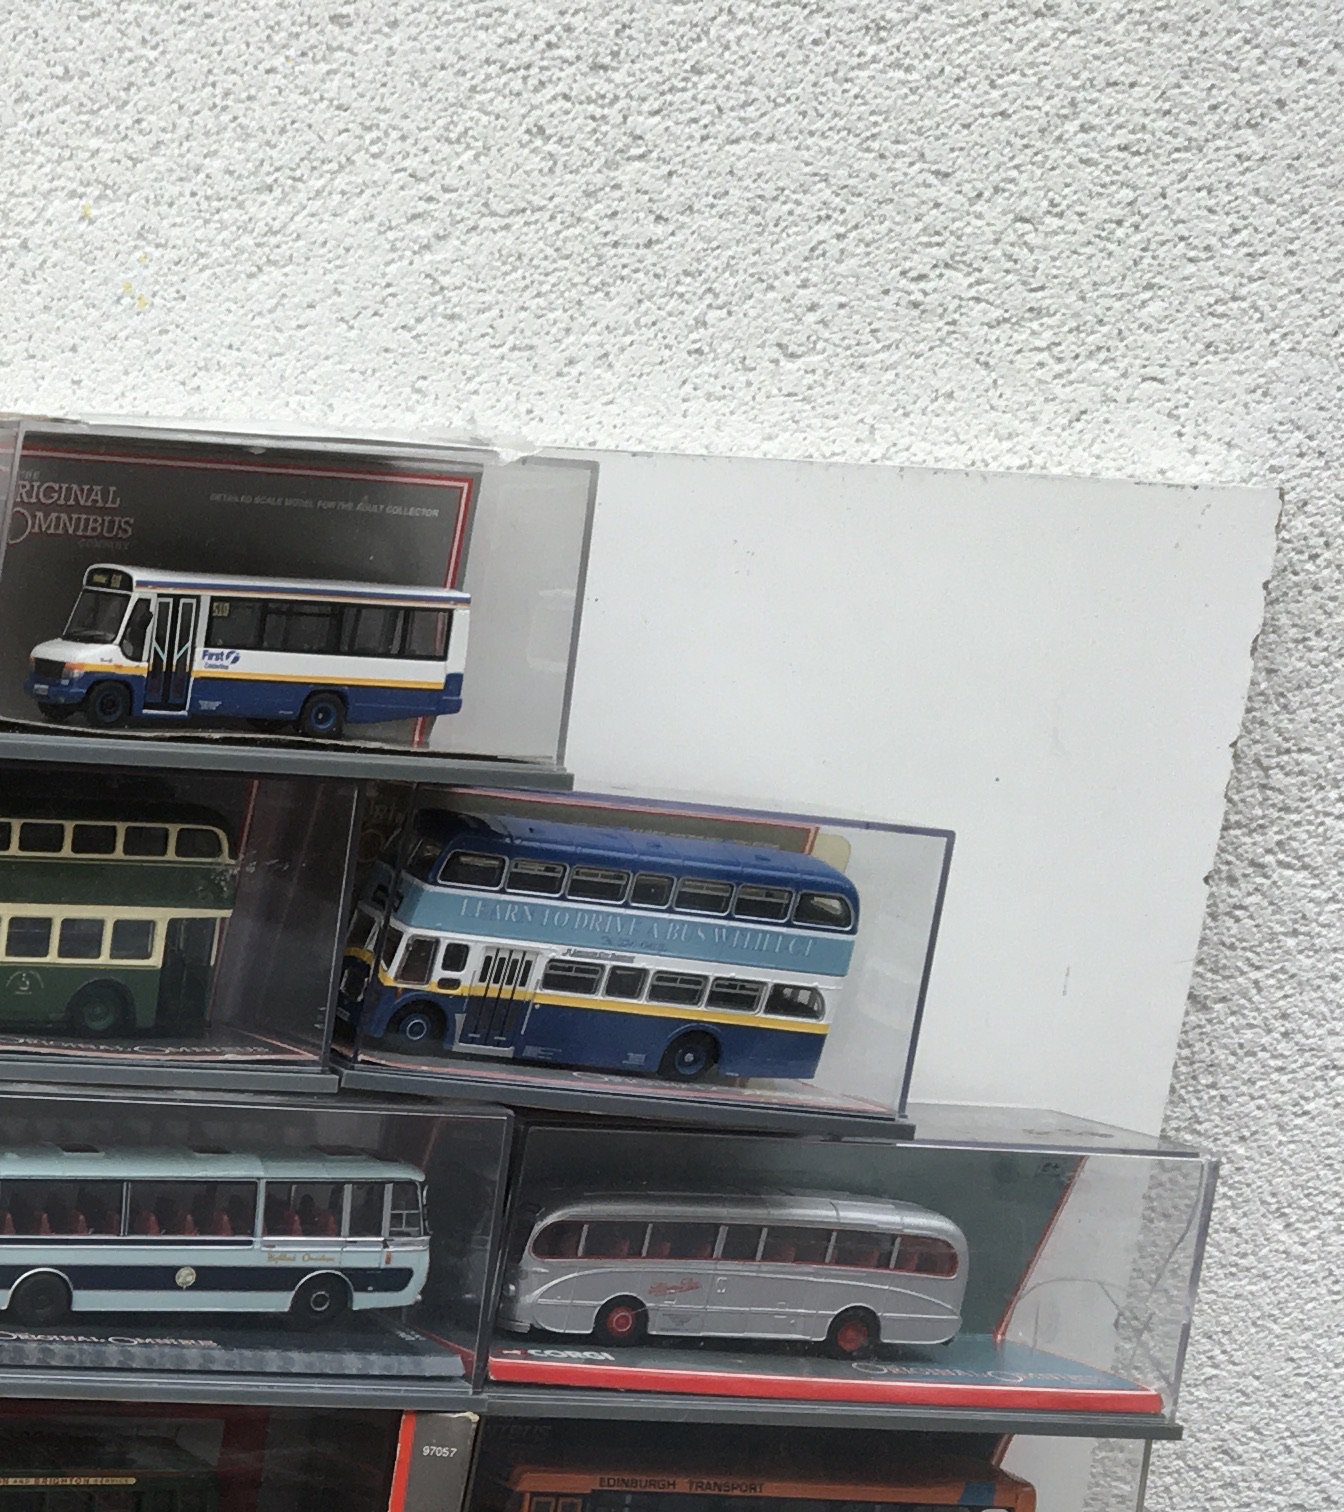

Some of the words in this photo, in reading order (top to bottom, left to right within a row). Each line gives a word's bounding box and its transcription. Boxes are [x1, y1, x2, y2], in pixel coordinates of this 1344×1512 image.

[202, 649, 225, 662] First
[423, 1446, 456, 1457] 97057
[599, 1477, 677, 1491] EDINBURGH
[689, 1481, 764, 1495] TRANSPORT
